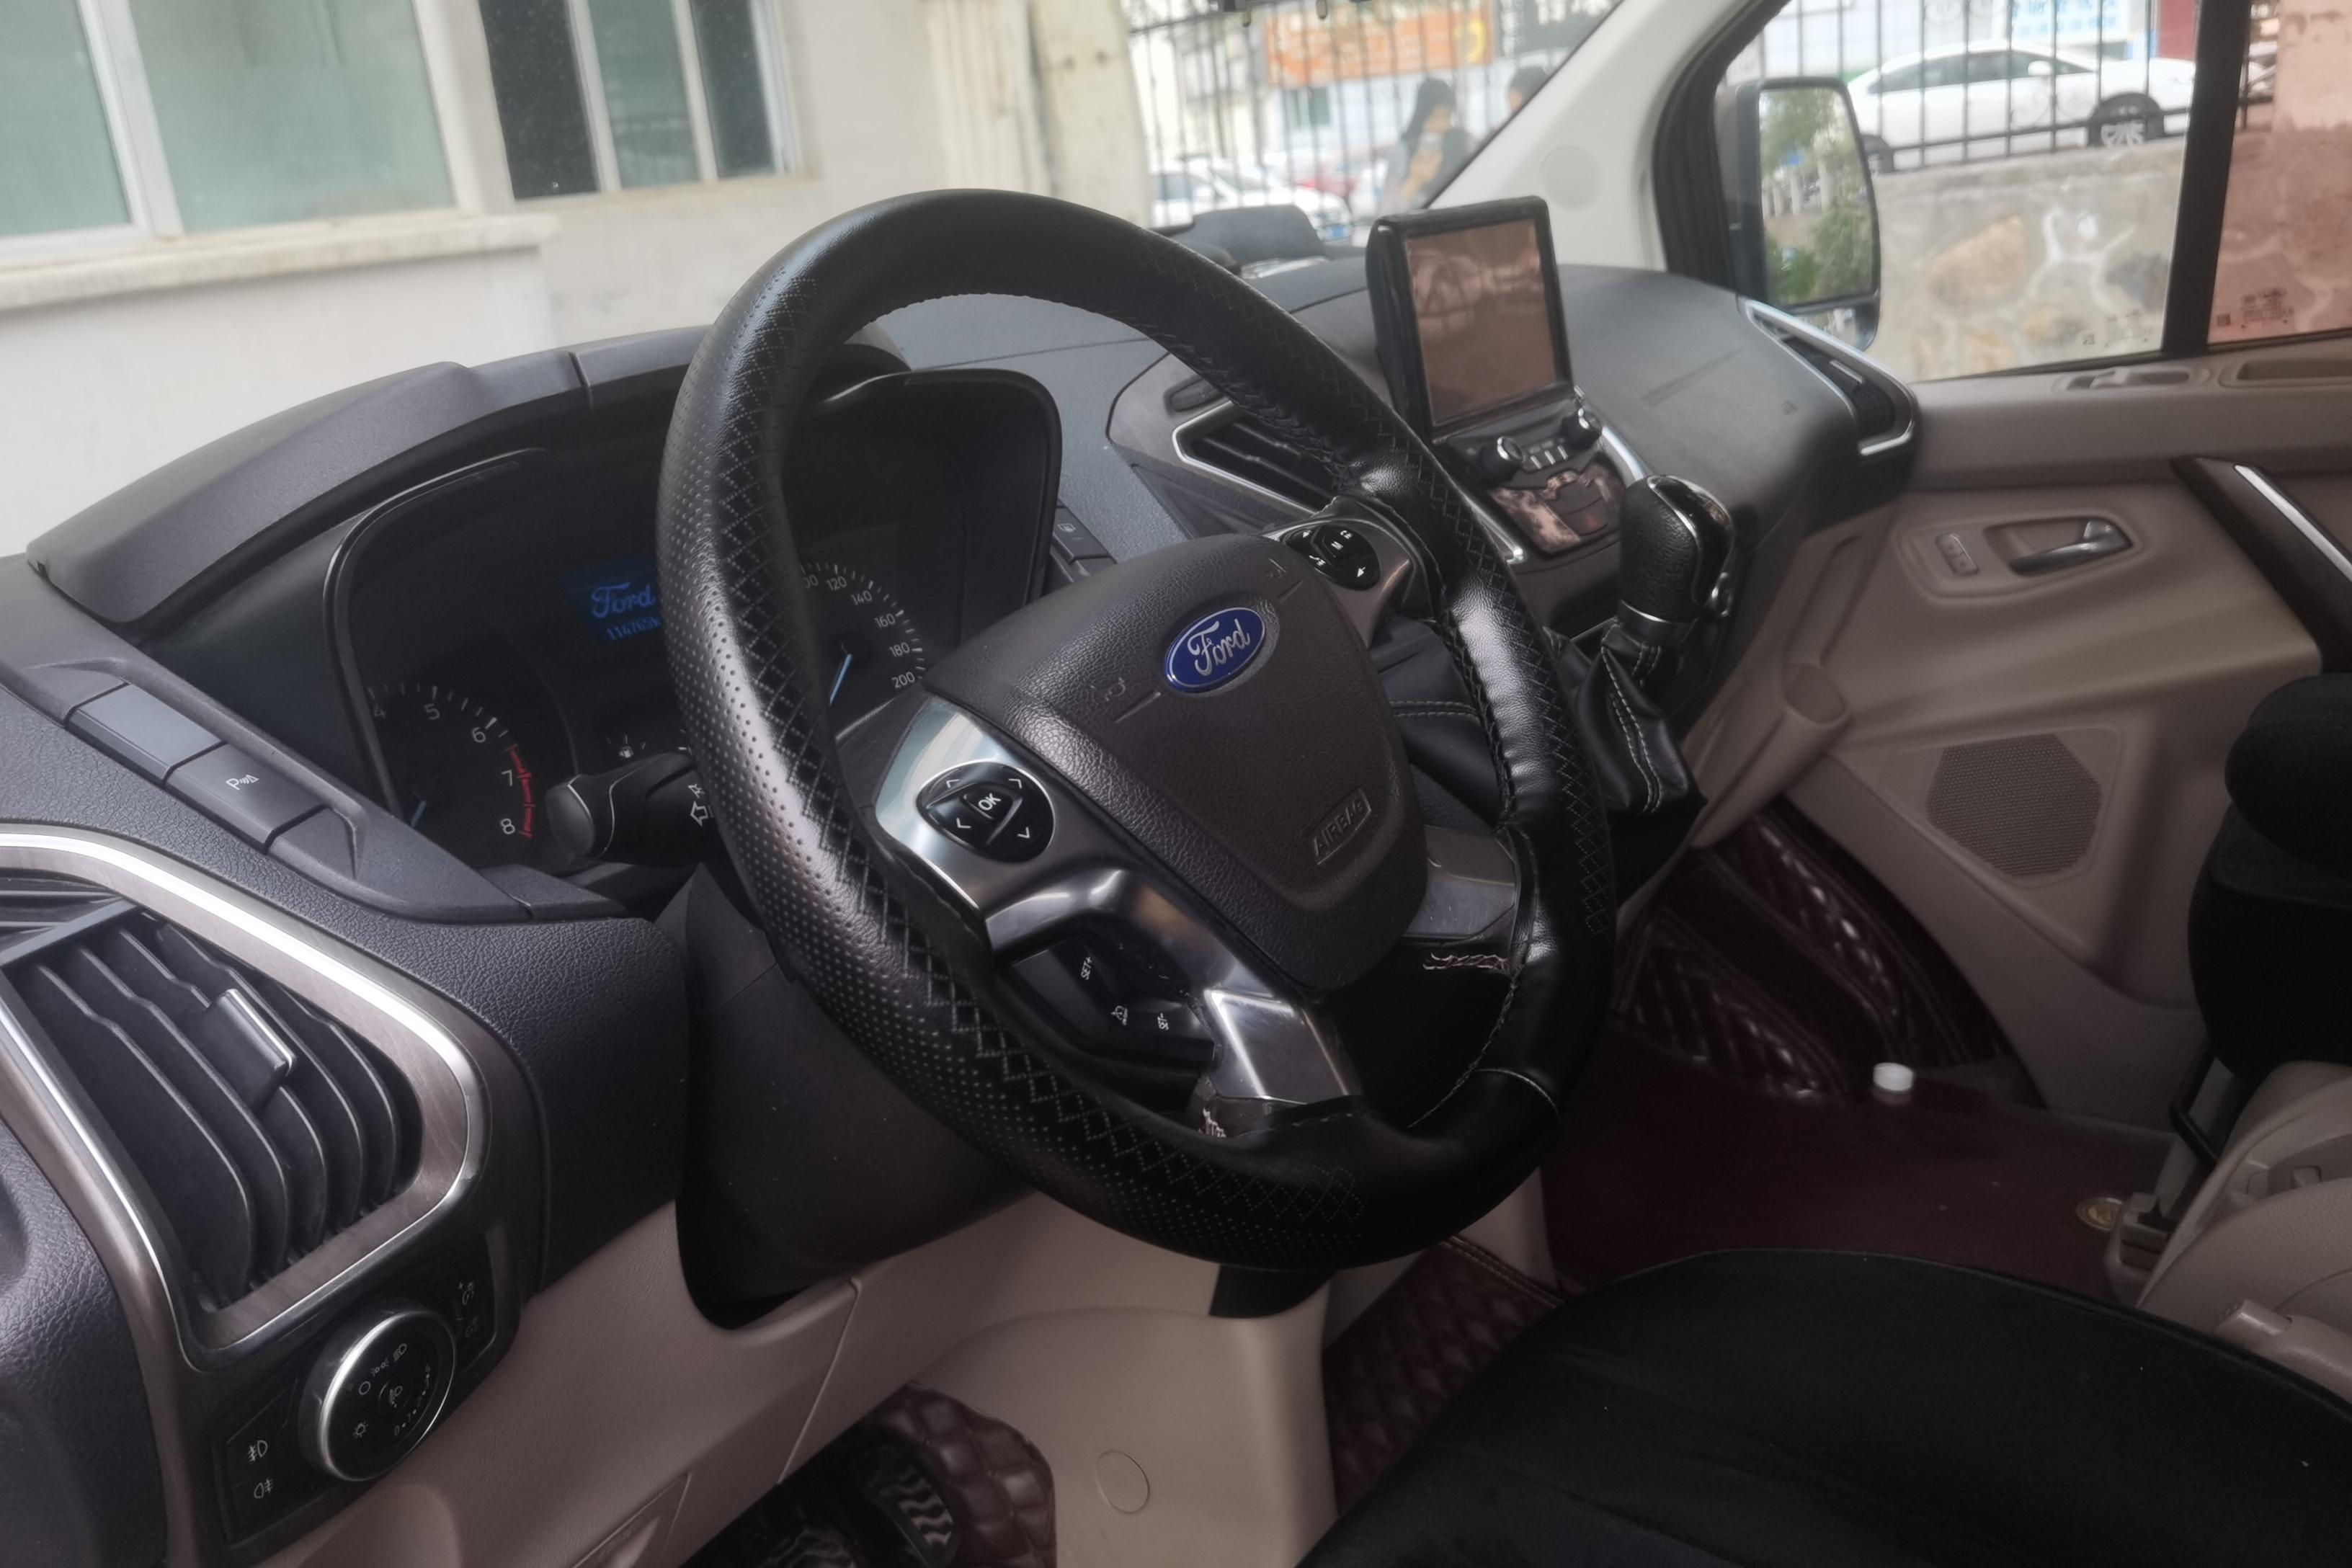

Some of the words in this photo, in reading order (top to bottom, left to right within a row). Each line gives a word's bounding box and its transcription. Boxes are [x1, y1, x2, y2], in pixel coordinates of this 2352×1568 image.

[802, 574, 819, 589] 00
[827, 576, 847, 591] 120
[592, 582, 656, 618] Ford
[851, 590, 872, 605] 140
[874, 613, 896, 628] 160
[889, 642, 910, 657] 180
[1188, 618, 1250, 676] Ford
[891, 672, 915, 688] 200
[374, 703, 386, 718] 4
[424, 703, 440, 720] 5
[472, 726, 486, 743] 6
[502, 770, 513, 786] 7
[978, 793, 1002, 811] OK
[501, 818, 516, 834] 8
[1314, 798, 1365, 857] AIRBAG
[1081, 956, 1092, 980] SET+
